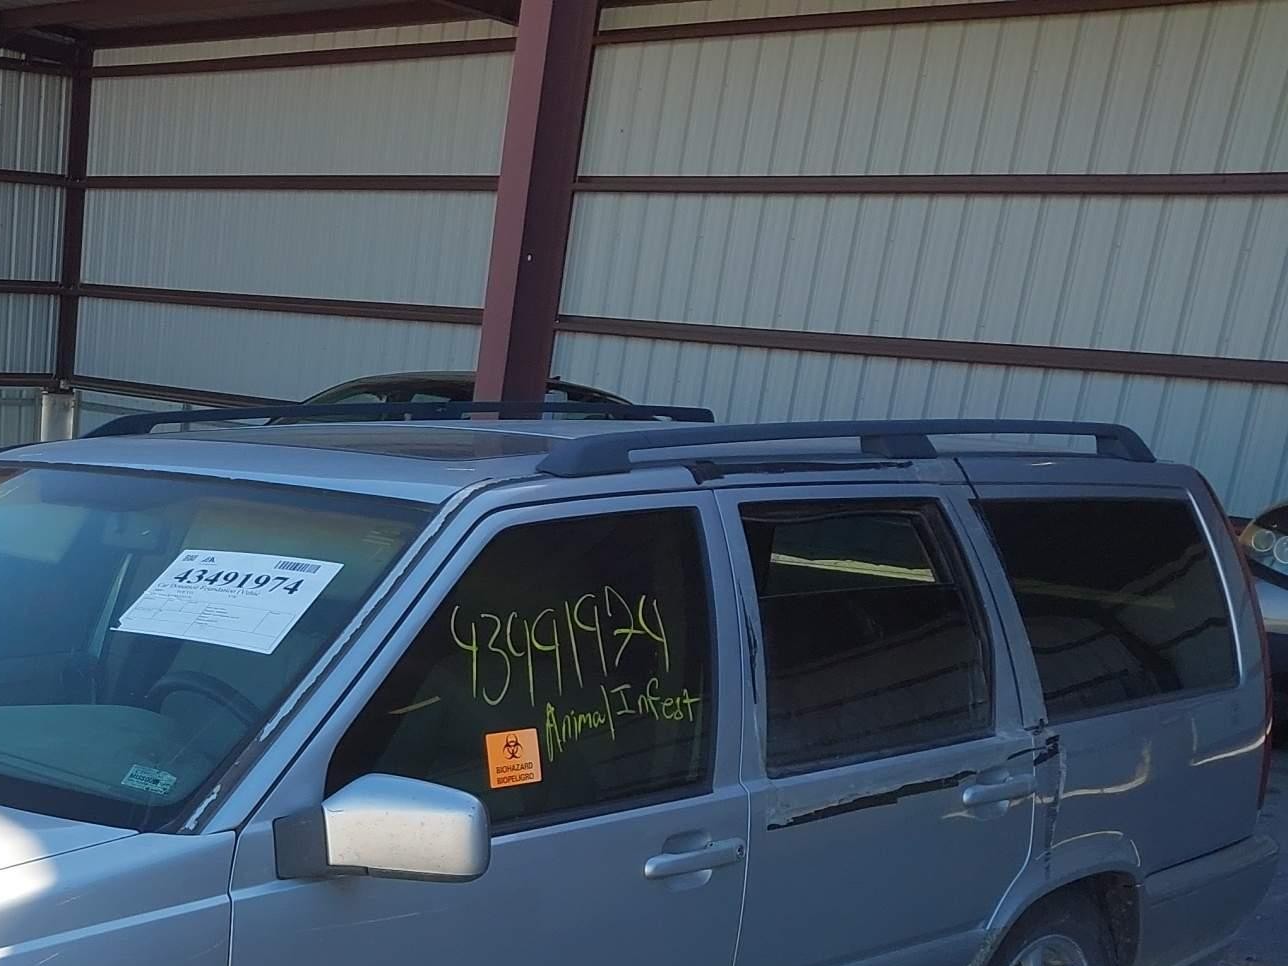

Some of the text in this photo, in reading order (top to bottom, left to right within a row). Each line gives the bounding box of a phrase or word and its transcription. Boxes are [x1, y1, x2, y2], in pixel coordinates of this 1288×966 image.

[174, 568, 305, 595] 43491974
[450, 586, 670, 707] 43491974
[545, 678, 700, 762] Animal Infest
[496, 762, 533, 774] BIOHAZARD
[497, 773, 535, 785] BIOPELIGRO
